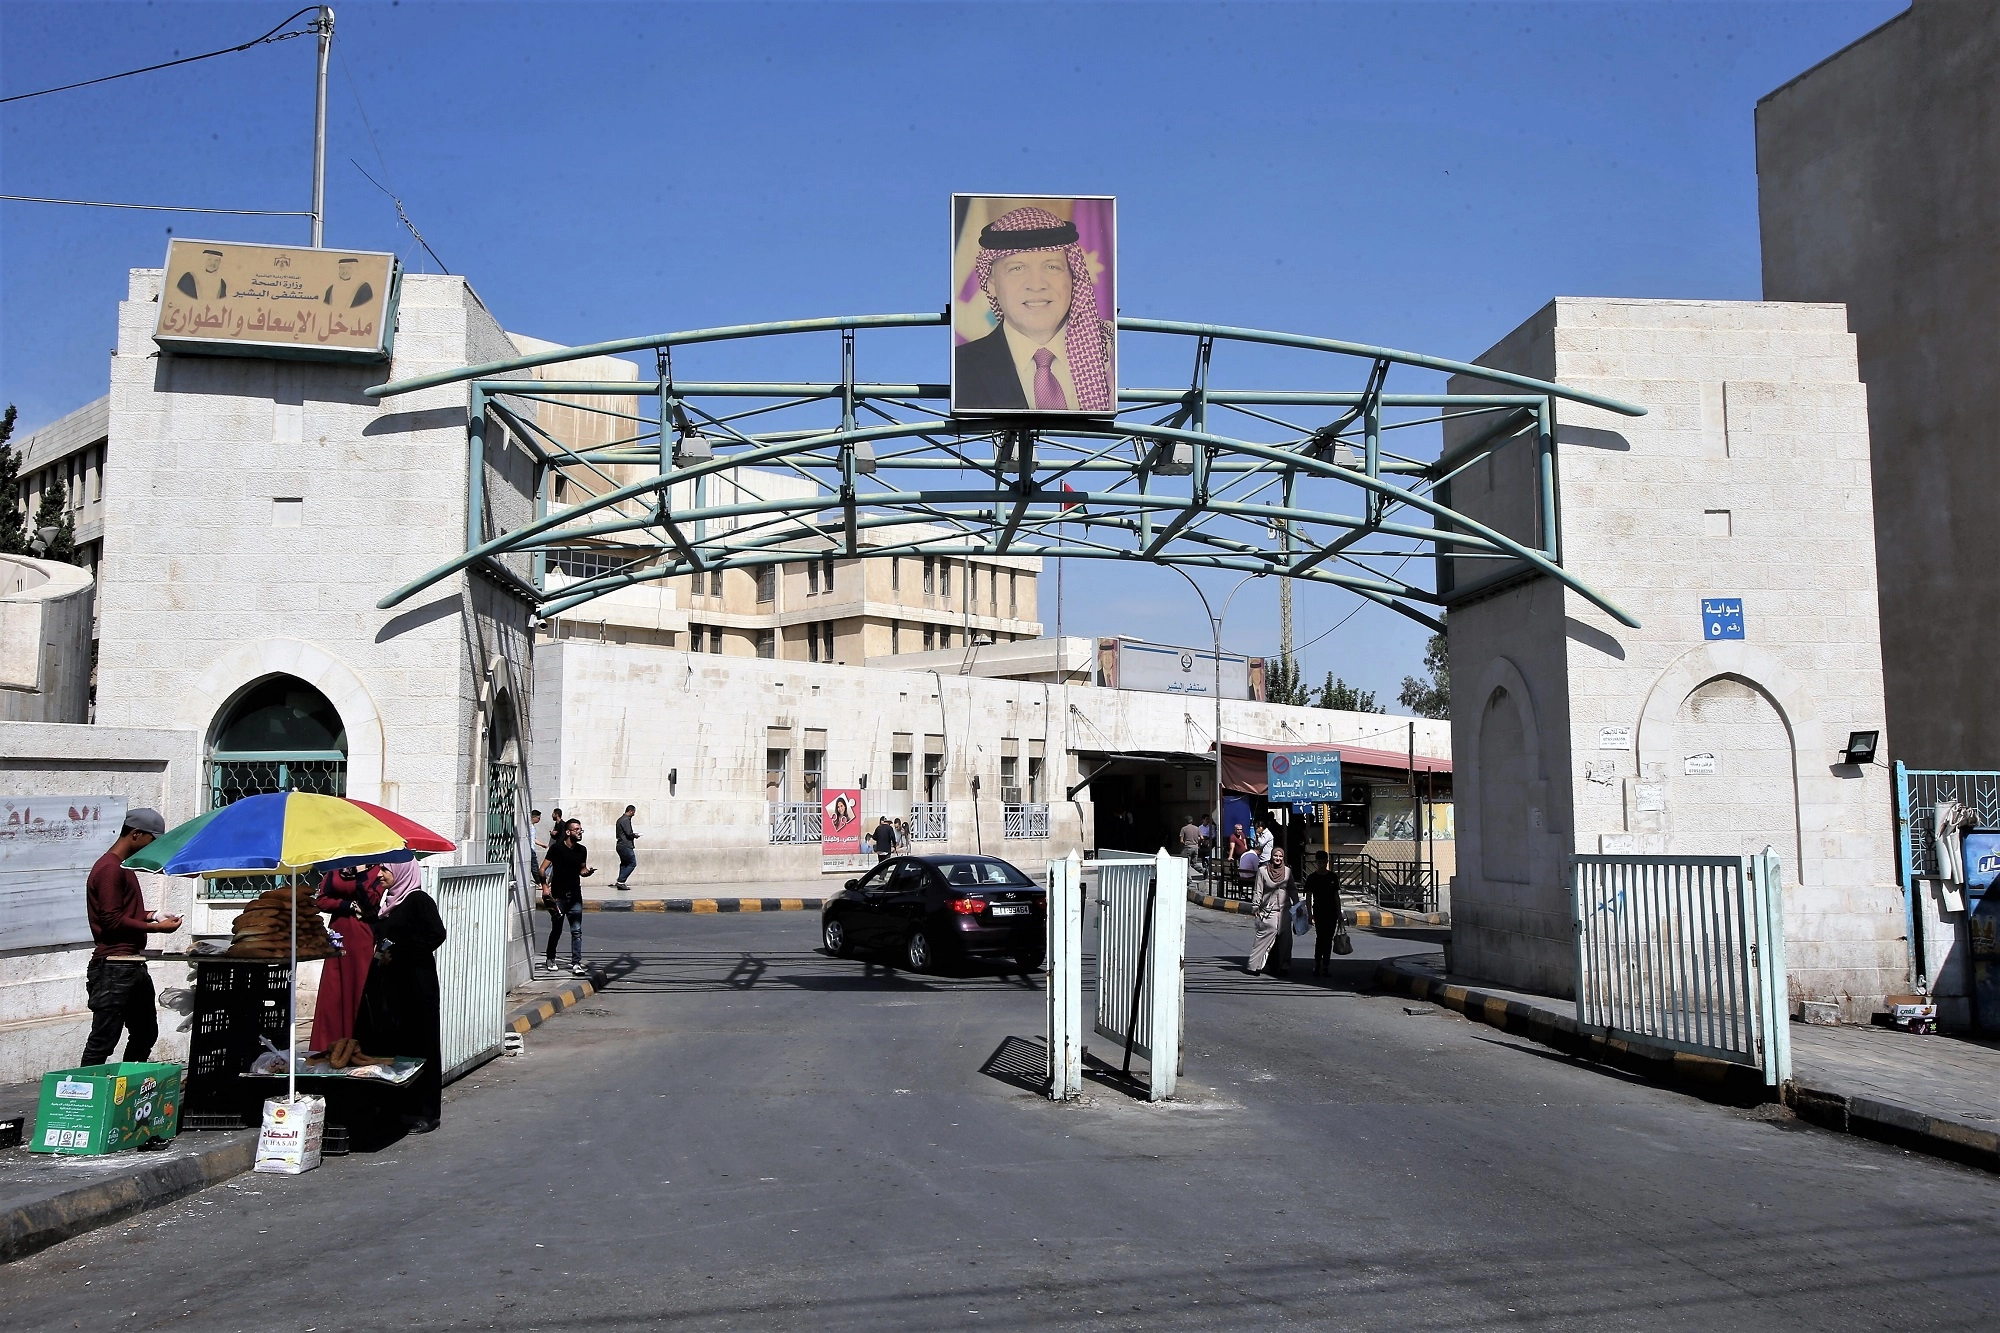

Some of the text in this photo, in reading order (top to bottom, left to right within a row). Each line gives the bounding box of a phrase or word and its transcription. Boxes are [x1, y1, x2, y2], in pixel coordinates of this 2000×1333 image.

[251, 278, 303, 290] وزارة الصحة
[232, 288, 319, 300] مستشفى البشير
[248, 307, 316, 341] الإسعاف
[318, 312, 373, 342] مدخل
[1704, 601, 1740, 618] بوابة
[1726, 622, 1741, 632] رقم
[1291, 754, 1338, 765] ممنوع الدخول
[1303, 768, 1330, 776] باستثناء
[1272, 778, 1337, 790] سيارات الإسعاف
[262, 1130, 298, 1138] الحصاد
